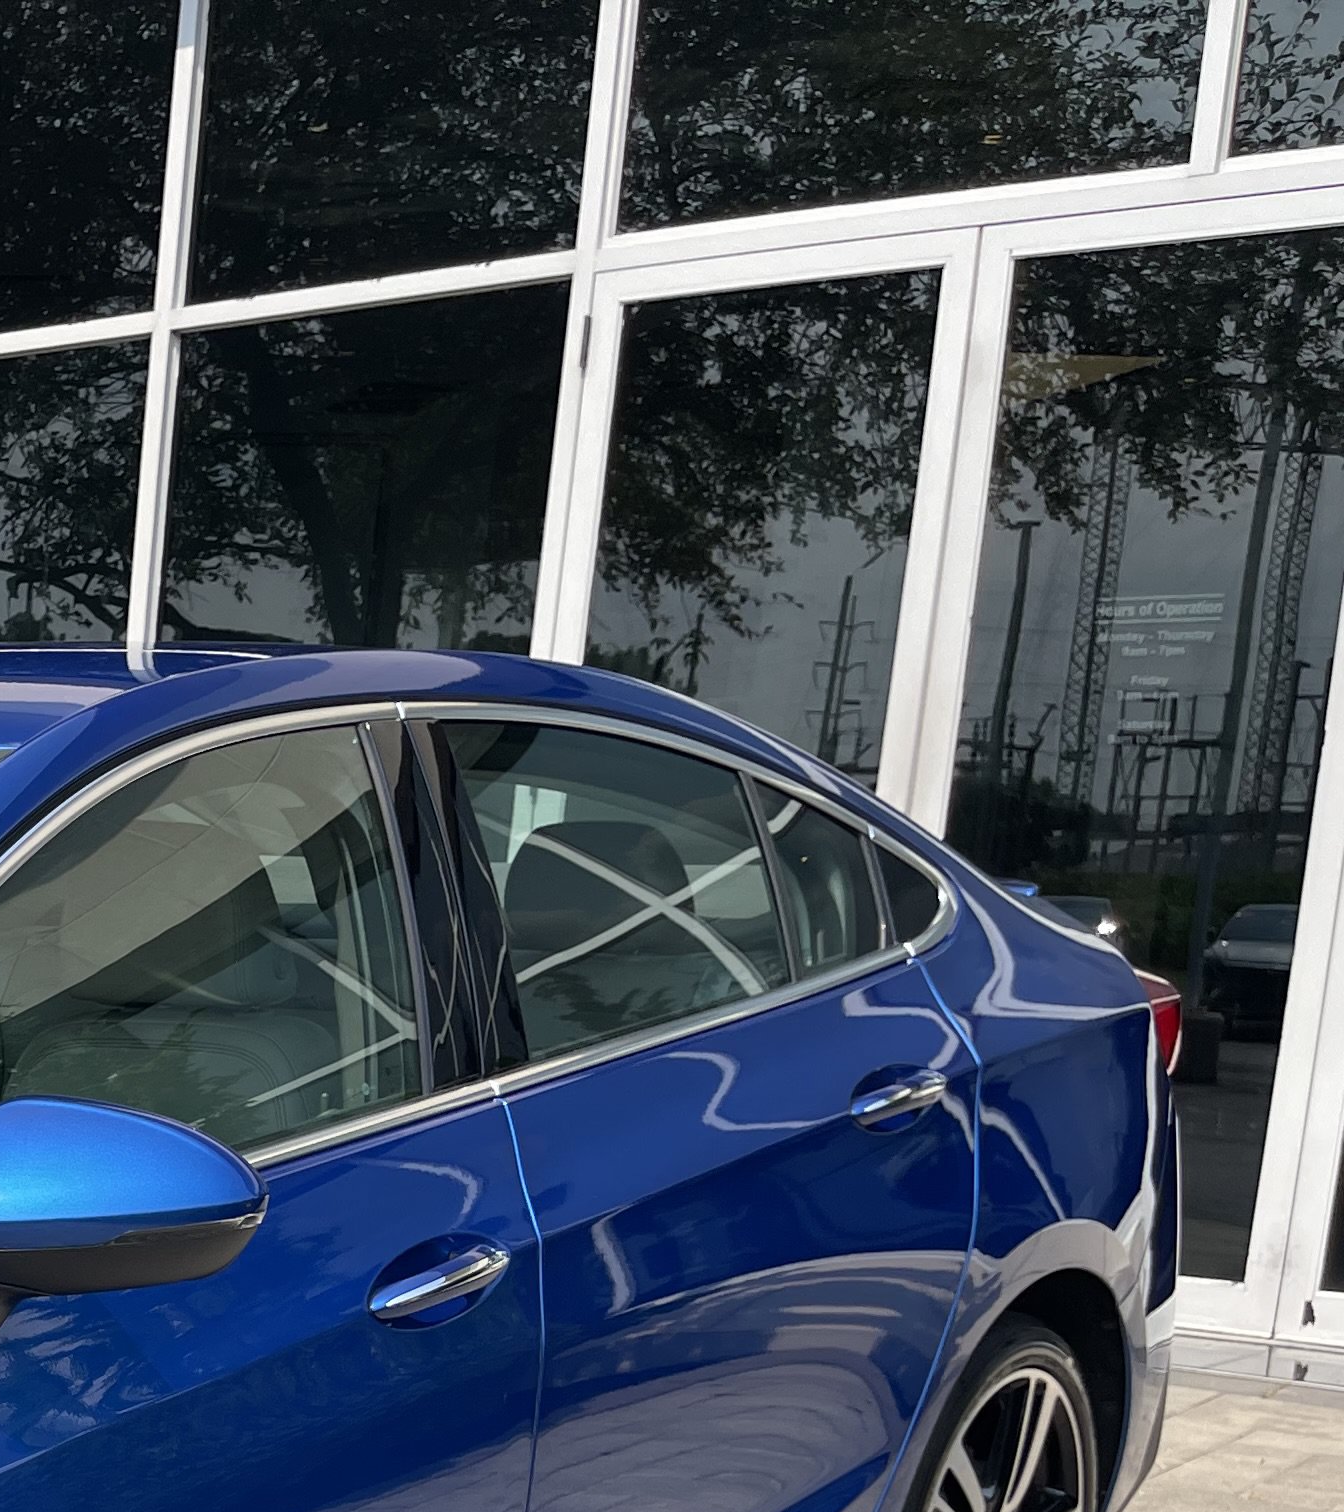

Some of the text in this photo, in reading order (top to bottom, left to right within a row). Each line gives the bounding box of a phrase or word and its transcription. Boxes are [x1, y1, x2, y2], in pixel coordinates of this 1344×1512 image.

[1095, 600, 1224, 618] Hours of Operation
[1157, 630, 1216, 643] Thursday
